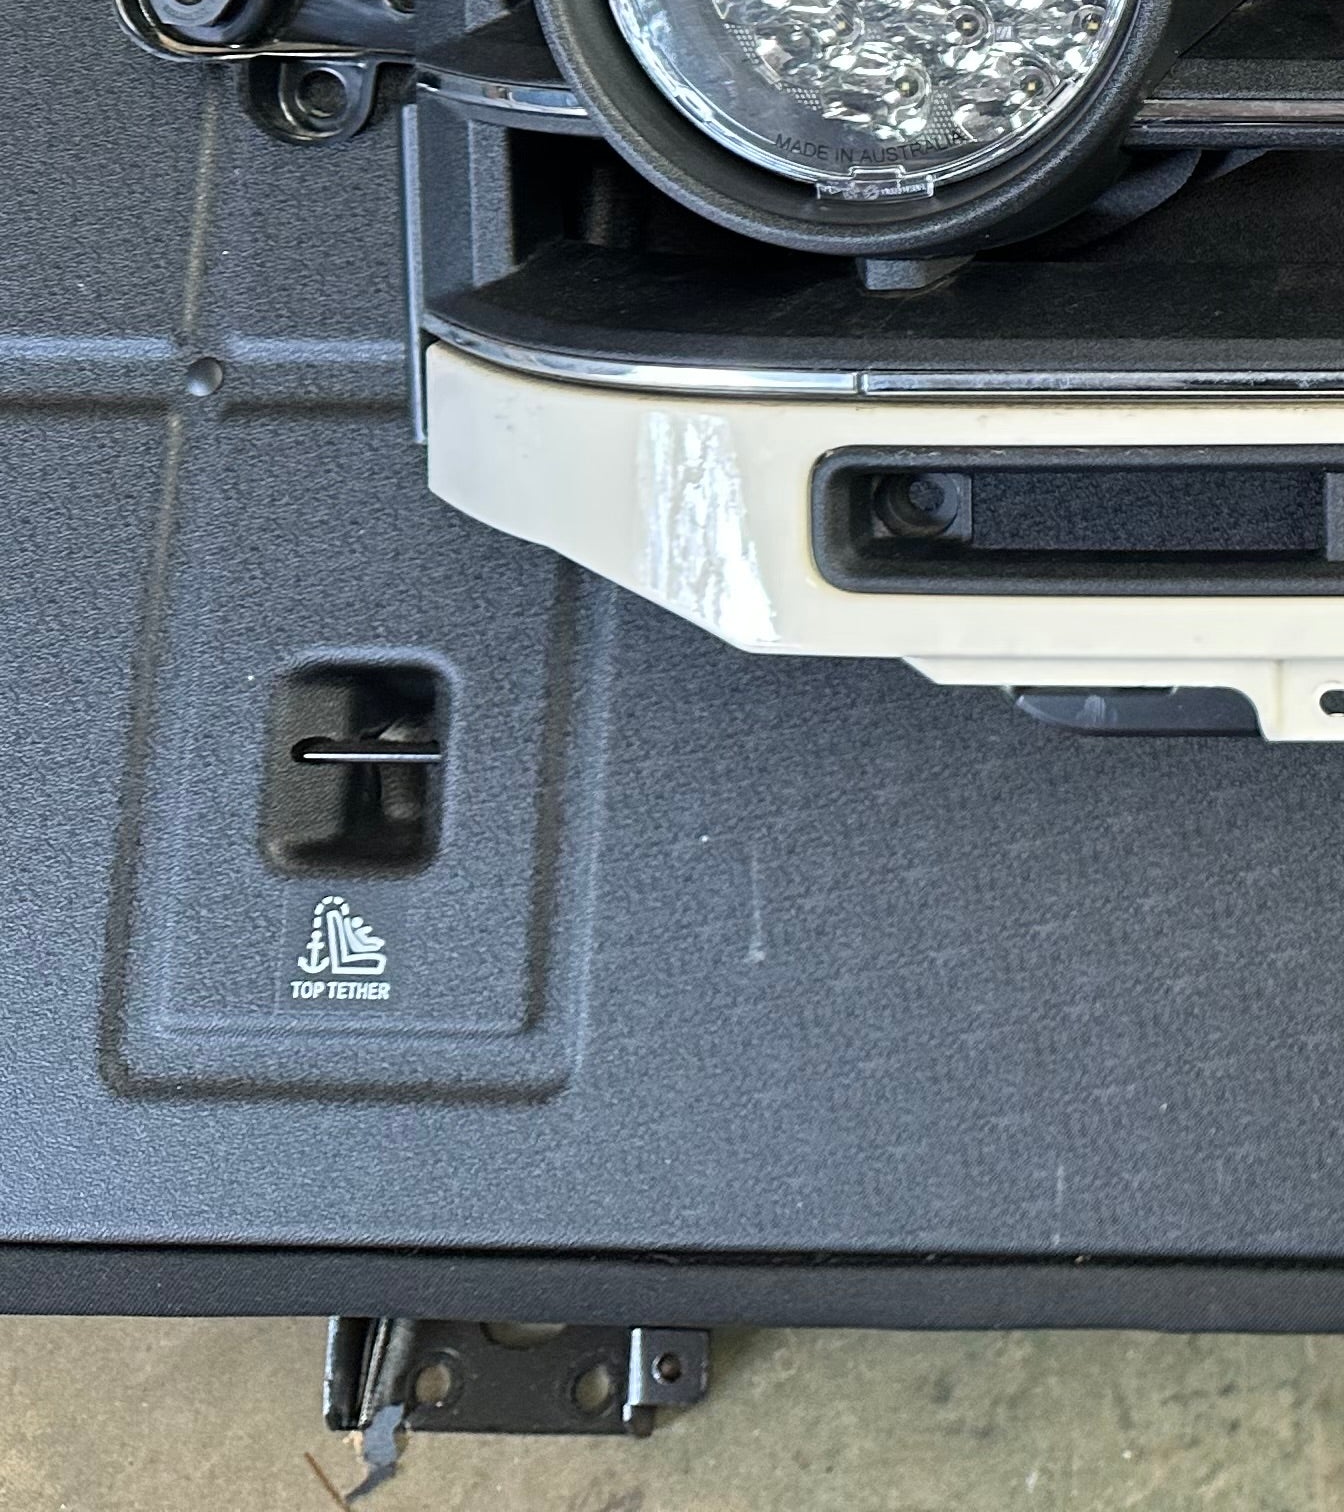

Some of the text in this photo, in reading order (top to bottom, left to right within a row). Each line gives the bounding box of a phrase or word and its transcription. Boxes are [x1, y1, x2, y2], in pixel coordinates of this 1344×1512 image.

[775, 130, 967, 164] MADE IN AUSTRALIA
[290, 980, 391, 1000] TOP TETHER
